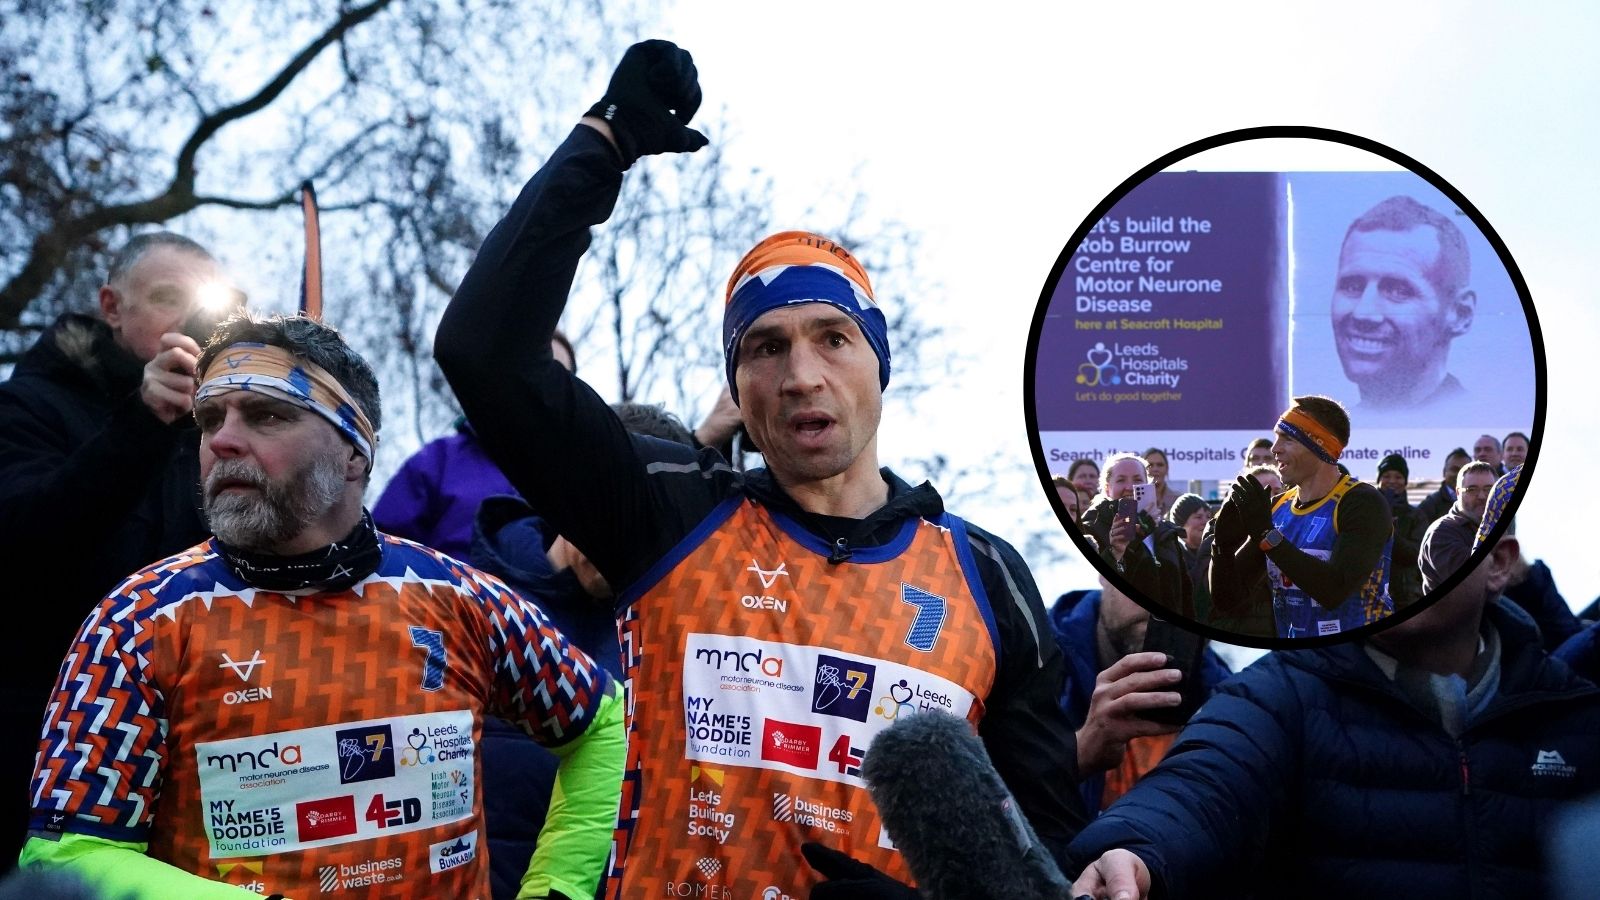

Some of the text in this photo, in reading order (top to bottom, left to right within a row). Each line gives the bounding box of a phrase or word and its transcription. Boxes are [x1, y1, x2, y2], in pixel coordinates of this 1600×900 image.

[1126, 216, 1173, 233] build
[1179, 217, 1211, 233] the
[1120, 236, 1190, 253] Burrow
[1075, 256, 1173, 273] Centre for
[1076, 276, 1222, 293] Motor Neurone
[1076, 296, 1152, 313] Disease
[1075, 319, 1223, 331] here at Seacroft Hospital
[1114, 343, 1159, 356] Leeds
[1121, 357, 1188, 373] Hospitals
[1124, 372, 1180, 388] Charity
[1076, 392, 1182, 403] Let's do good together
[1050, 449, 1103, 462] Search
[1164, 448, 1236, 463] Hospitals
[1308, 517, 1327, 543] 7
[741, 596, 787, 612] OXEN
[902, 582, 946, 652] 7
[408, 626, 447, 692] 7
[696, 649, 783, 677] mnda
[720, 684, 760, 692] association
[744, 676, 774, 687] neurone
[776, 682, 804, 692] disease
[846, 670, 868, 699] 7
[223, 687, 272, 705] OXEN
[687, 696, 714, 711] MY
[916, 684, 952, 708] Leeds
[427, 724, 458, 737] Leeds
[689, 726, 752, 745] DODDIE
[366, 734, 386, 761] 7
[783, 744, 810, 752] RIMMER
[207, 742, 302, 772] mnda
[239, 763, 330, 782] motor neurone disease
[431, 770, 447, 780] Irish
[240, 778, 286, 789] association
[431, 781, 450, 791] Motor
[210, 799, 235, 813] MY
[432, 799, 456, 810] Disease
[794, 796, 853, 822] business
[213, 820, 285, 840] DODDIE
[216, 837, 286, 851] foundation
[341, 857, 402, 877] business
